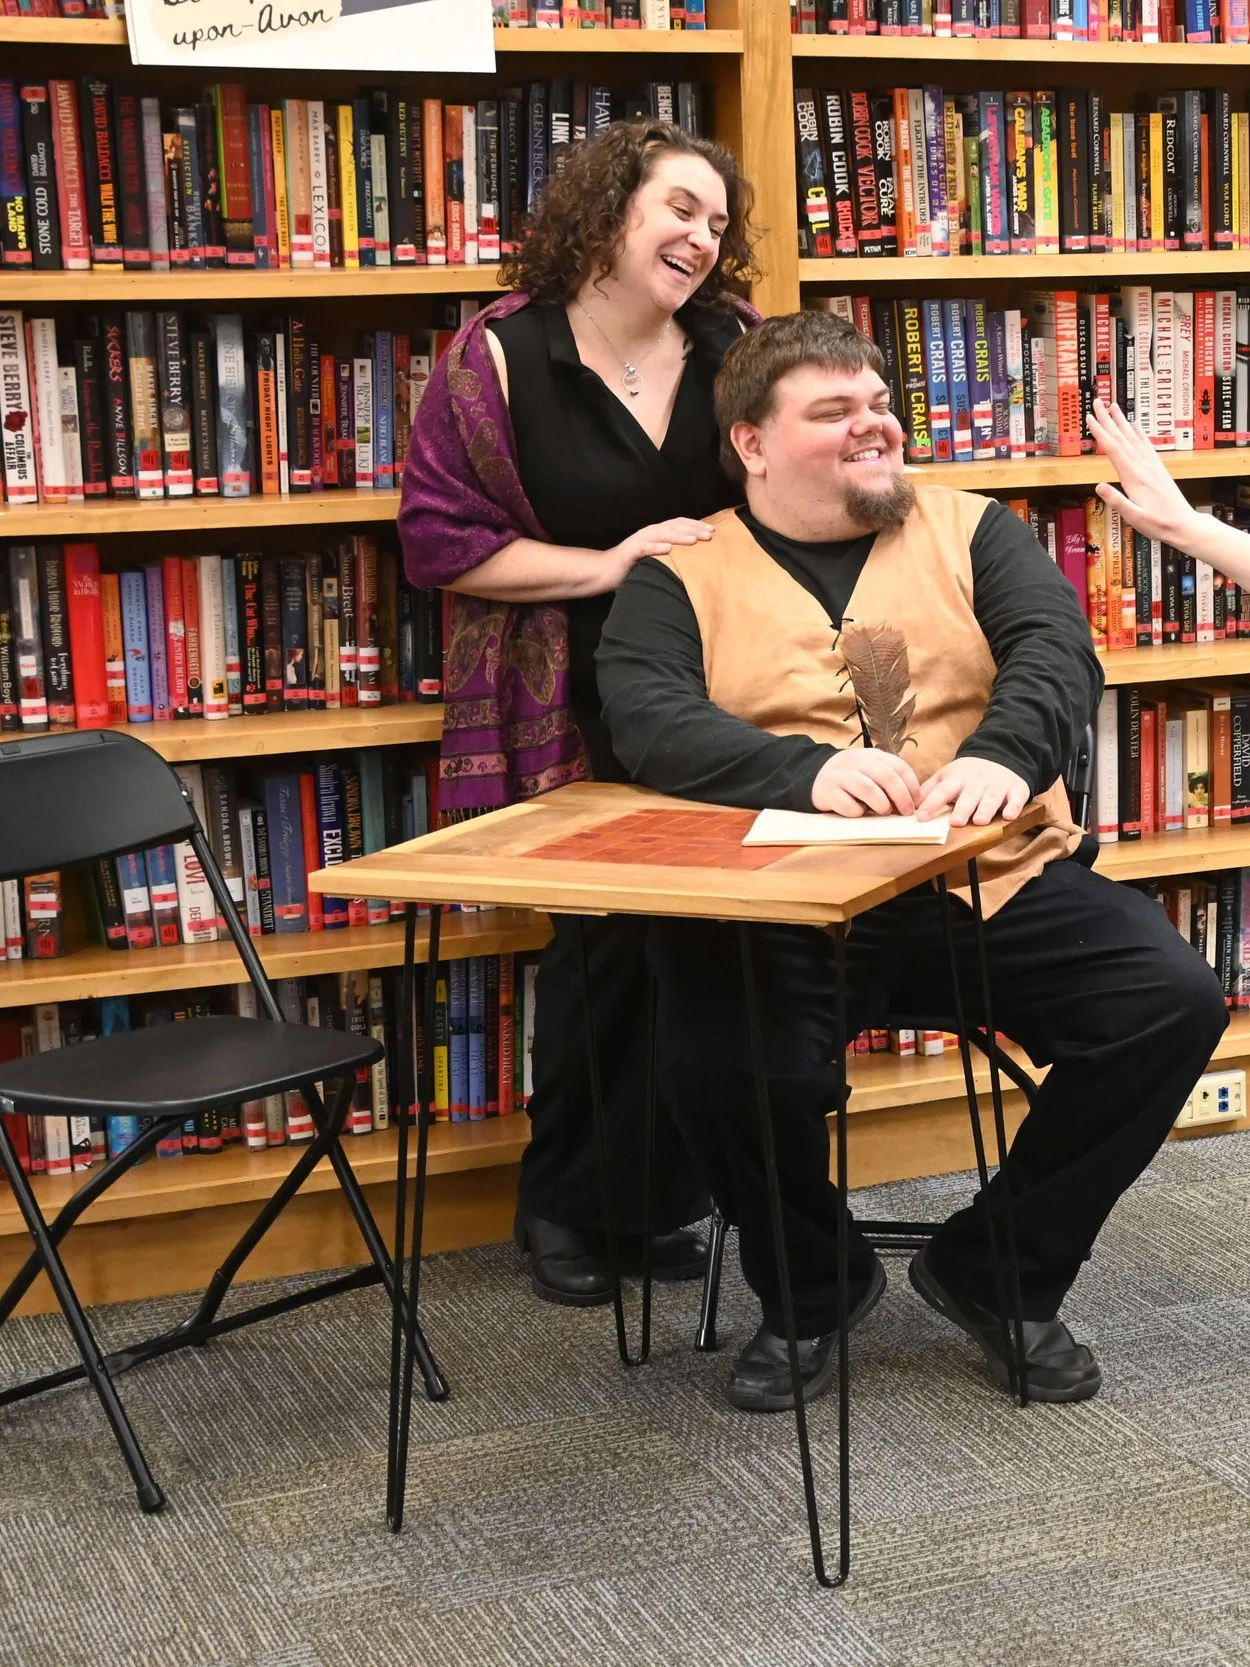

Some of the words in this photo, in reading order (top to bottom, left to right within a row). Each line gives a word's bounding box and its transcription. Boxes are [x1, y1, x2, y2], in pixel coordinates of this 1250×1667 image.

[173, 4, 332, 51] upon-Avon
[57, 84, 74, 129] DAVID
[94, 97, 108, 129] DAVID
[532, 103, 543, 148] GLENN
[797, 102, 811, 142] COOK
[807, 101, 818, 141] ROBIN
[826, 95, 844, 144] ROBIN
[852, 92, 869, 126] ROBIN
[399, 121, 407, 158] MUTINY
[855, 127, 872, 160] COOK
[876, 121, 885, 160] COOK
[882, 121, 891, 161] ROBIN
[900, 120, 910, 150] PARKER
[1014, 107, 1026, 178] CALIBAN'S
[1166, 119, 1176, 174] REDCOAT
[61, 131, 79, 188] BALDACCI
[96, 130, 112, 183] BALDACCI
[183, 140, 192, 195] AFFLICTION
[532, 150, 544, 189] BECK
[832, 151, 849, 195] COOK
[916, 162, 924, 180] THE
[34, 187, 48, 216] COLD
[451, 201, 459, 219] LOUIS
[858, 164, 878, 226] VECTOR
[879, 179, 888, 216] CURE
[886, 177, 895, 218] FATAL
[1017, 180, 1028, 212] WAR
[7, 202, 16, 232] LAND
[68, 210, 84, 246] TARGET
[38, 220, 51, 254] STONE
[930, 303, 941, 338] ROBERT
[950, 303, 961, 338] ROBERT
[975, 303, 985, 337] ROBERT
[1097, 304, 1110, 353] MICHAEL
[1138, 292, 1149, 326] MICHAEL
[1180, 313, 1192, 342] PREY
[1205, 298, 1213, 334] MICHAEL
[1222, 296, 1232, 330] MICHAEL
[1, 315, 18, 360] STEVE
[166, 316, 180, 359] STEVE
[904, 308, 923, 374] ROBERT
[1056, 301, 1077, 387] AIRFRAME
[1157, 299, 1171, 360] MICHAEL
[106, 325, 124, 383] SUCKERS
[930, 340, 947, 384] CRAIS
[950, 340, 966, 383] CRAIS
[975, 340, 990, 382] CRAIS
[1205, 335, 1213, 377] CRICHTON
[1222, 332, 1232, 372] CRICHTON
[3, 364, 22, 410] BERRY
[169, 361, 183, 406] BERRY
[363, 381, 371, 425] JENNIFER
[1157, 368, 1172, 436] CRICHTON
[1222, 376, 1232, 398] STATE
[113, 398, 124, 428] ANNE
[264, 401, 272, 425] NIGHT
[356, 385, 364, 424] BLAKE
[910, 392, 928, 446] CRAIS
[1062, 391, 1070, 433] CRICHTON
[1222, 408, 1232, 429] FEAR
[5, 441, 17, 471] AFFAIR
[15, 433, 28, 480] COLUMBUS
[116, 432, 128, 476] BILLSON
[265, 426, 273, 466] LIGHTS
[342, 554, 353, 584] Simon
[1112, 551, 1120, 579] SPREE
[341, 586, 354, 618] Brett
[187, 628, 199, 679] FAHRENHEIT
[3, 681, 12, 704] Boyd
[1130, 690, 1139, 718] COLIN
[1130, 720, 1140, 758] DEXTER
[1233, 715, 1242, 787] COPPERFIELD
[1242, 733, 1250, 768] DAVID
[219, 794, 229, 829] SANDRA
[223, 832, 233, 867] BROWN
[502, 1056, 511, 1085] HEAT
